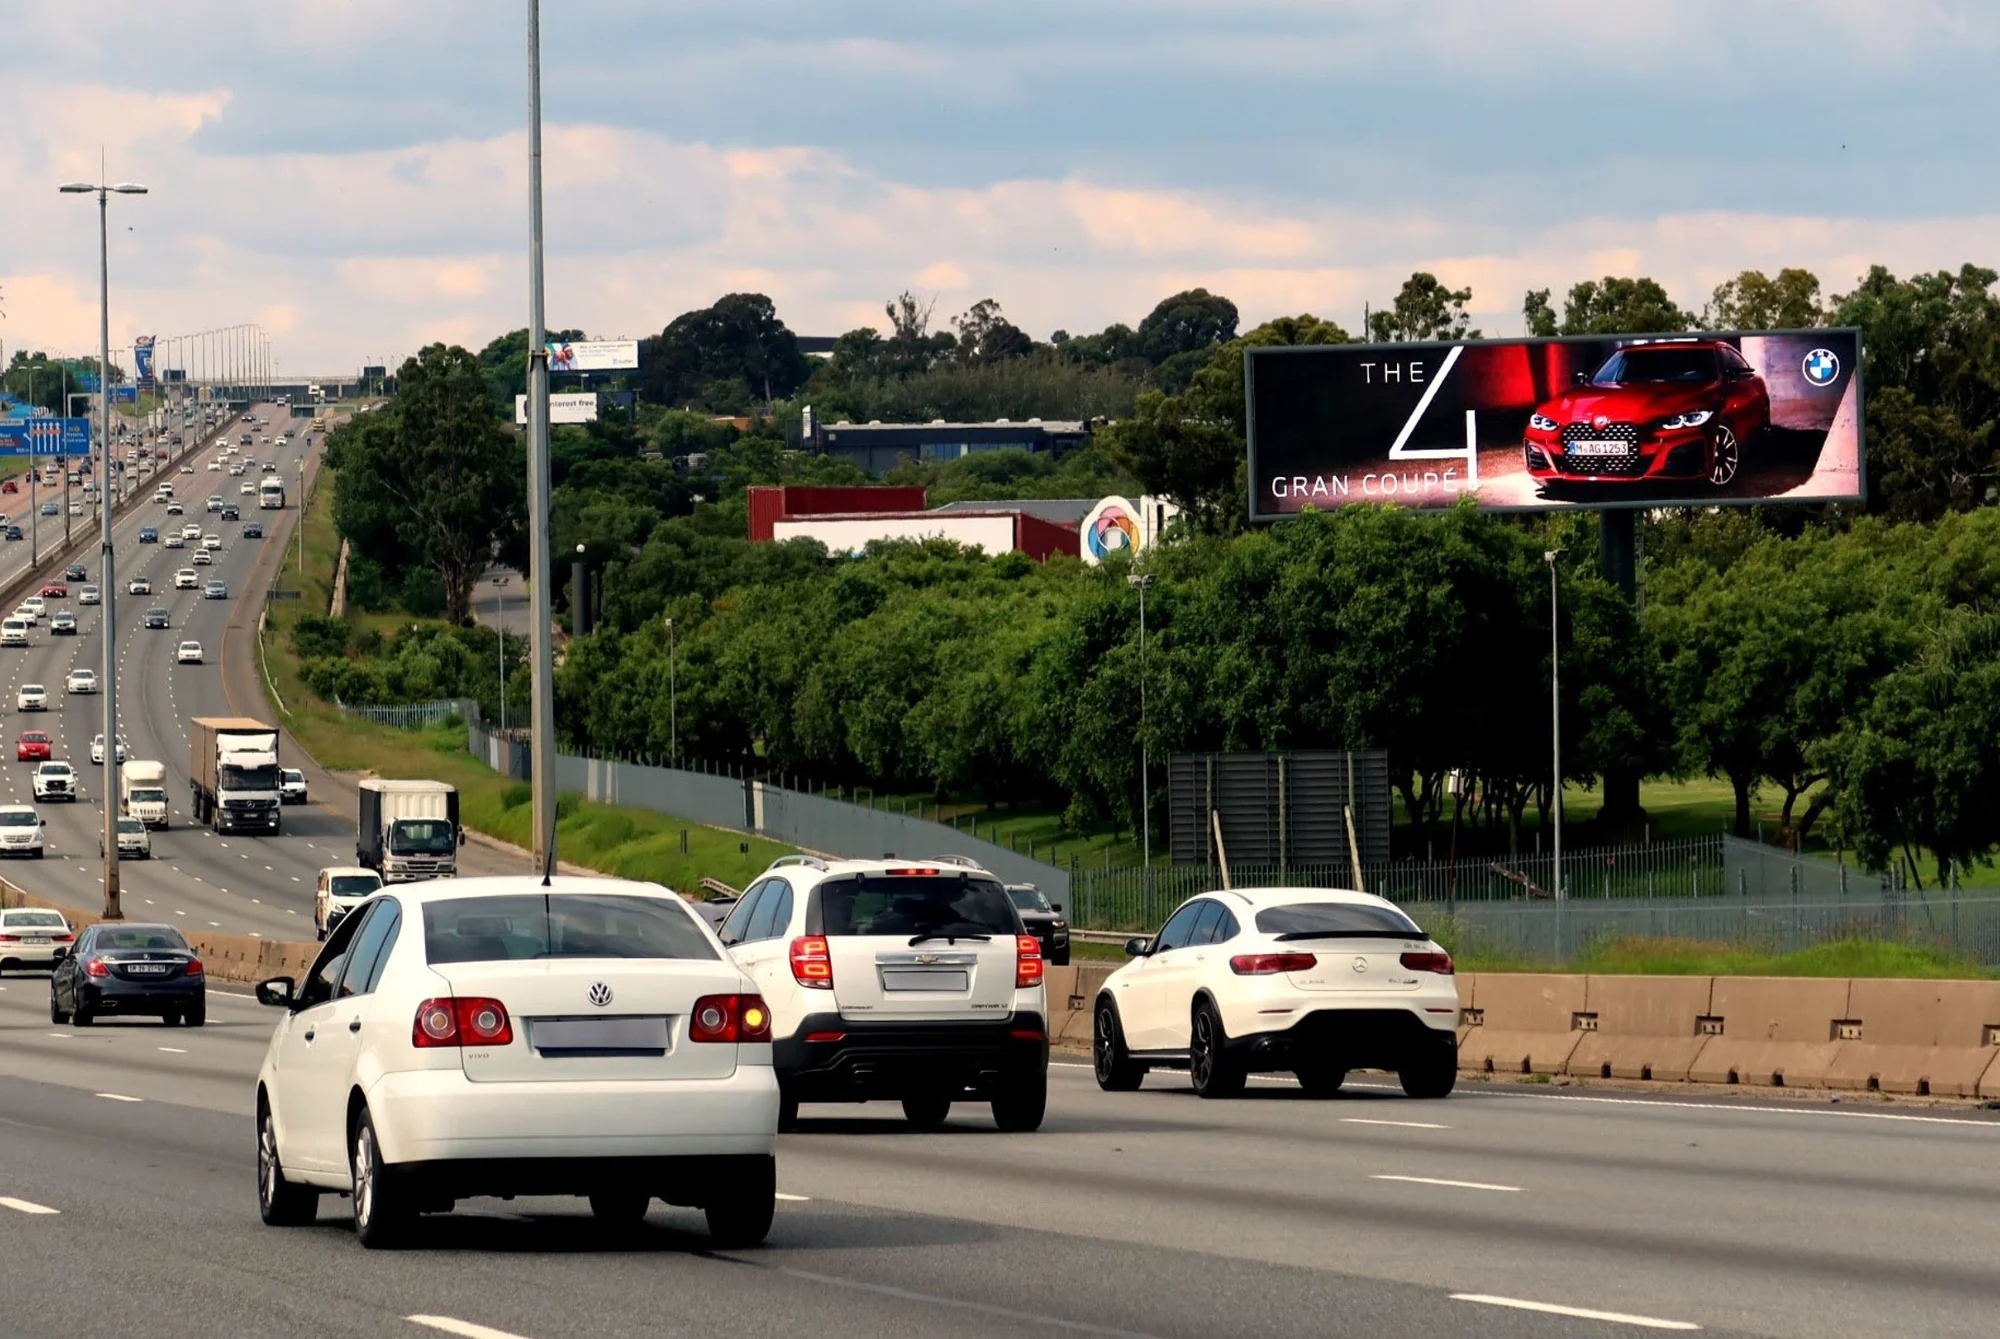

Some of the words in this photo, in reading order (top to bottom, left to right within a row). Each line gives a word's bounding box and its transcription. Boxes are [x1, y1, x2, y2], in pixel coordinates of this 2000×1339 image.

[1360, 361, 1424, 384] THE
[548, 400, 577, 408] nterest
[578, 399, 594, 407] free
[1388, 345, 1479, 491] 4
[1271, 475, 1349, 498] GRAN
[1362, 467, 1457, 496] COUPÉ
